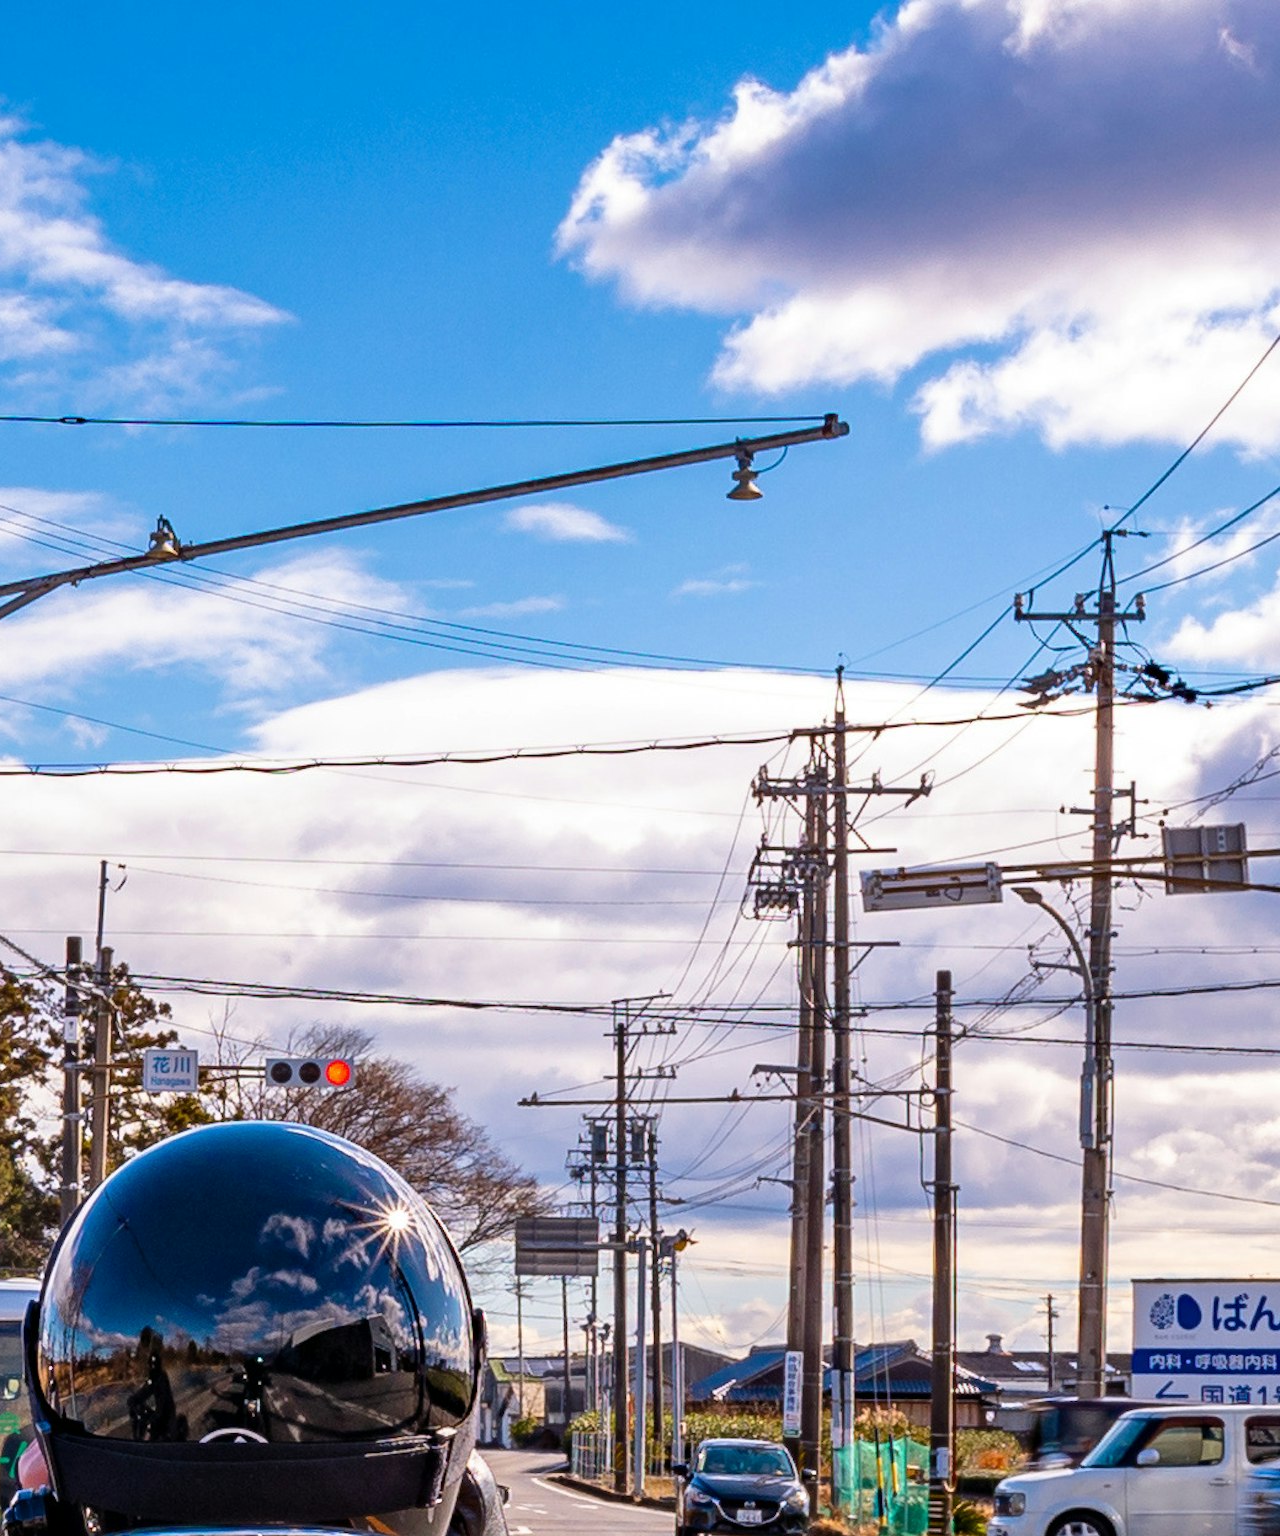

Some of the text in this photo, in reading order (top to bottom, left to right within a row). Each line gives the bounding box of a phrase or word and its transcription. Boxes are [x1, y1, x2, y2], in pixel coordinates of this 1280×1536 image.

[152, 1056, 190, 1074] 花川
[1213, 1292, 1280, 1332] ばん
[1148, 1354, 1278, 1371] 内科・呼吸器内科
